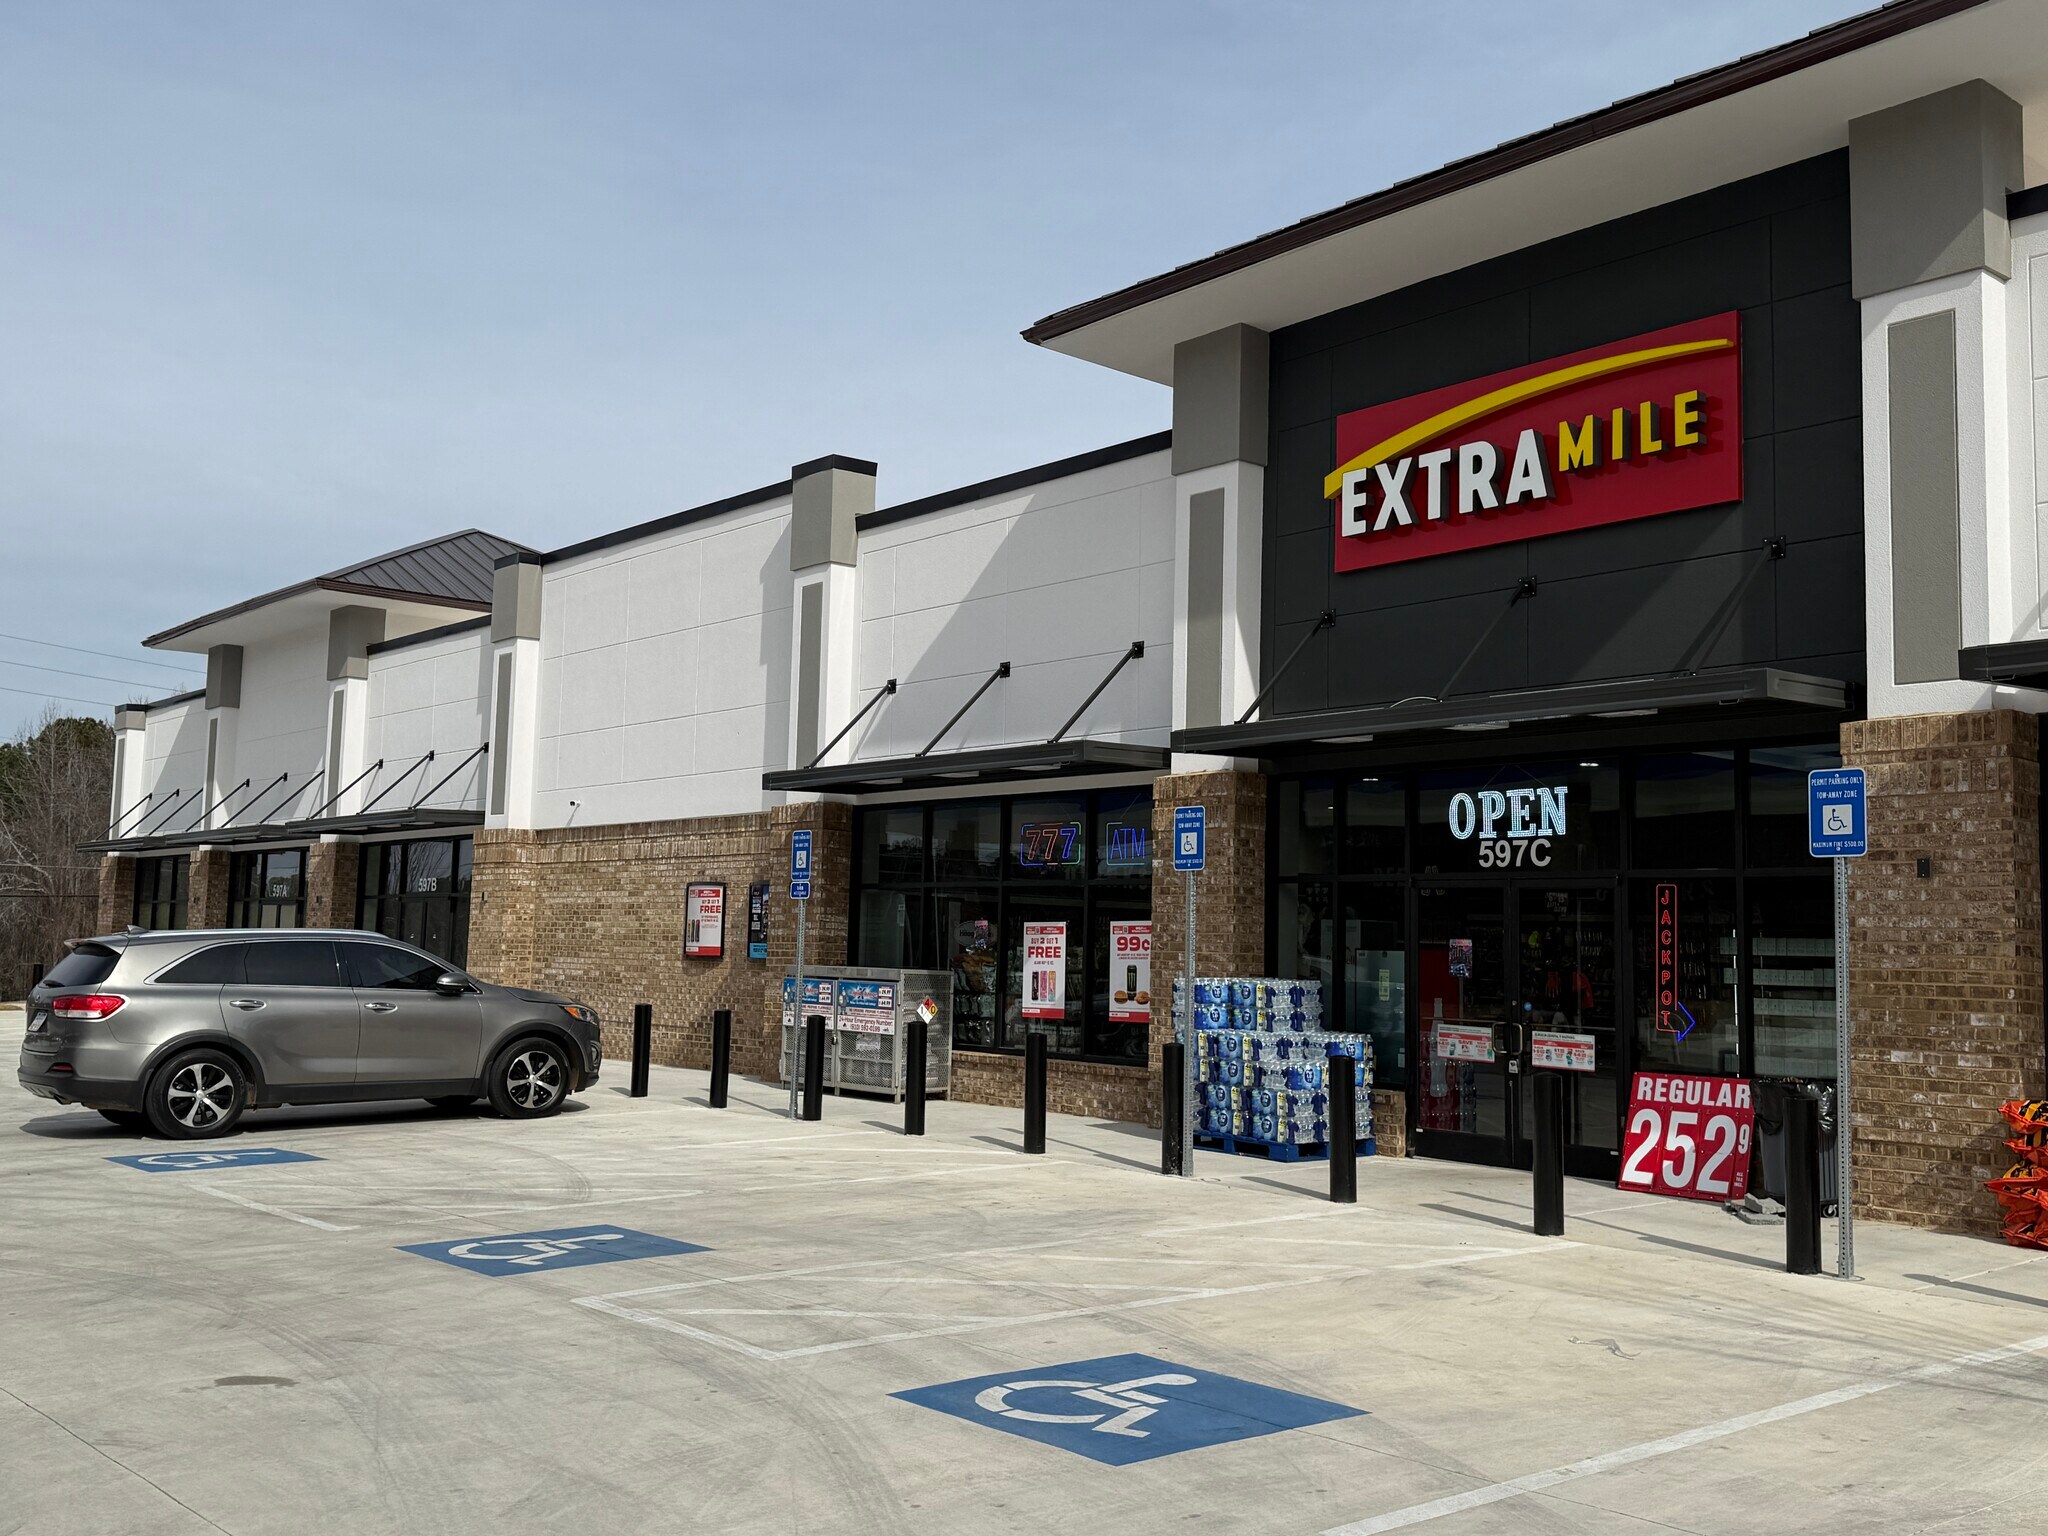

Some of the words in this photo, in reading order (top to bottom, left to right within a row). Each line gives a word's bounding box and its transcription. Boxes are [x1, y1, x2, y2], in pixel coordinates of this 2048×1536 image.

[1341, 428, 1549, 538] EXTRA
[1558, 389, 1701, 473] MILE
[1816, 790, 1842, 798] TOW-AWAY
[1448, 787, 1569, 840] OPEN
[1025, 828, 1077, 860] 777
[1110, 828, 1146, 860] ATM
[1478, 839, 1552, 867] 597C
[272, 884, 288, 898] 597A
[418, 877, 437, 892] 597B
[700, 905, 721, 914] FREE
[1117, 936, 1150, 952] 99¢
[1028, 946, 1061, 958] FREE
[1660, 889, 1673, 1026] JACKPOT
[924, 998, 929, 1006] 4
[931, 1006, 935, 1014] 0
[854, 1017, 875, 1027] Emergency
[1636, 1076, 1751, 1109] REGULAR
